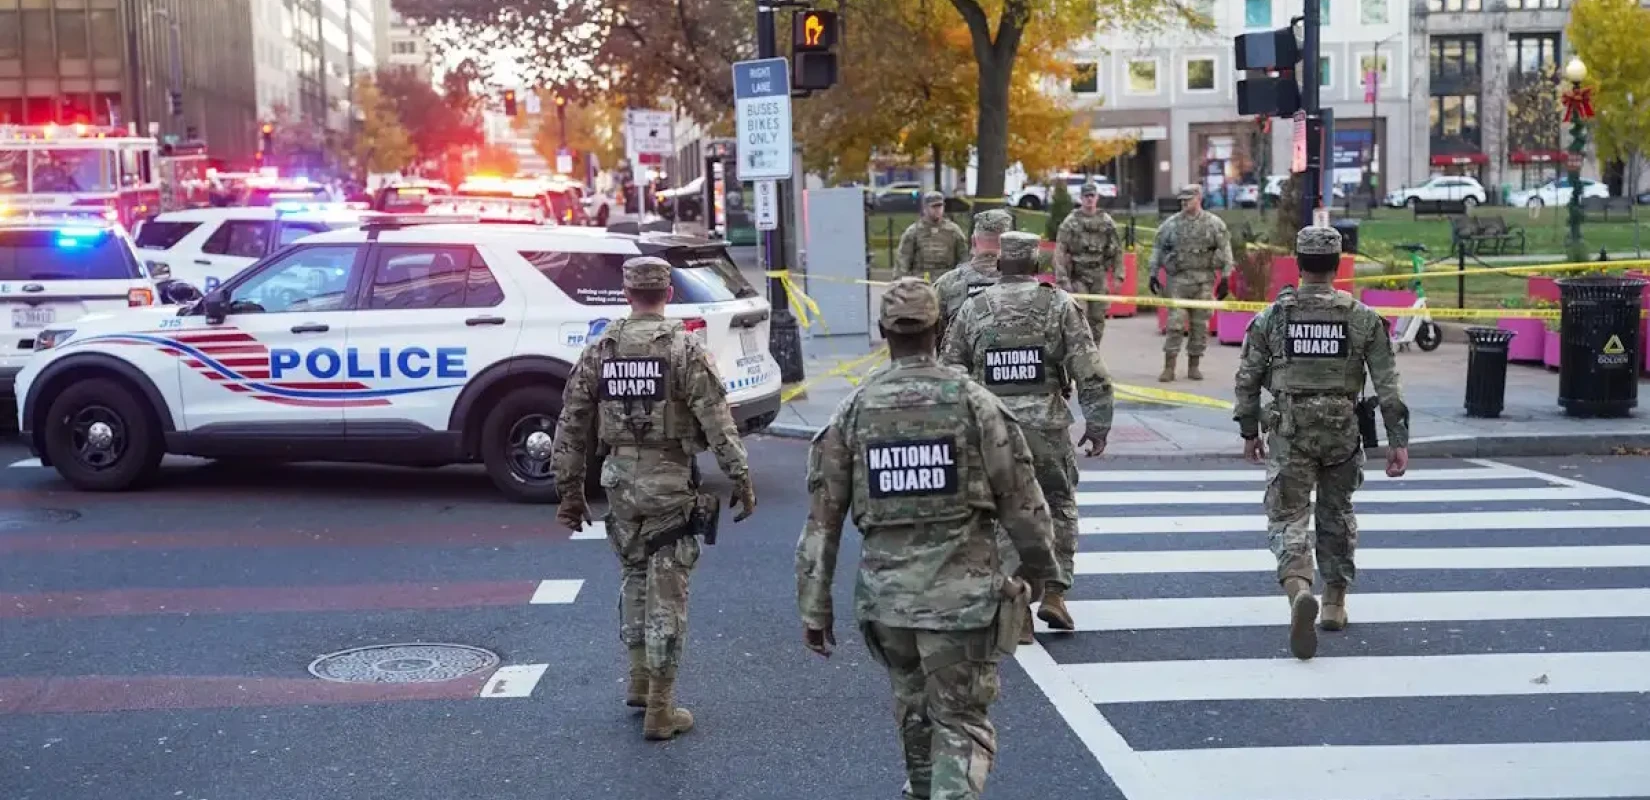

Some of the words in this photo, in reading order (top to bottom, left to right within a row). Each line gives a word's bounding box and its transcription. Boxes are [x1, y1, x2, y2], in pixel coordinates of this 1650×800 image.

[750, 67, 771, 78] RIGHT
[751, 81, 772, 93] LANE
[747, 102, 779, 116] BUSES
[747, 117, 780, 131] BIKES
[748, 132, 778, 145] ONLY
[159, 319, 182, 328] 315
[1288, 323, 1346, 339] NATIONAL
[1293, 339, 1339, 354] GUARD
[270, 347, 468, 379] POLICE
[986, 349, 1042, 366] NATIONAL
[1598, 356, 1628, 364] GOLDEN
[603, 361, 663, 379] NATIONAL
[992, 365, 1037, 381] GUARD
[607, 379, 656, 396] GUARD
[869, 444, 954, 470] NATIONAL
[880, 467, 946, 492] GUARD
